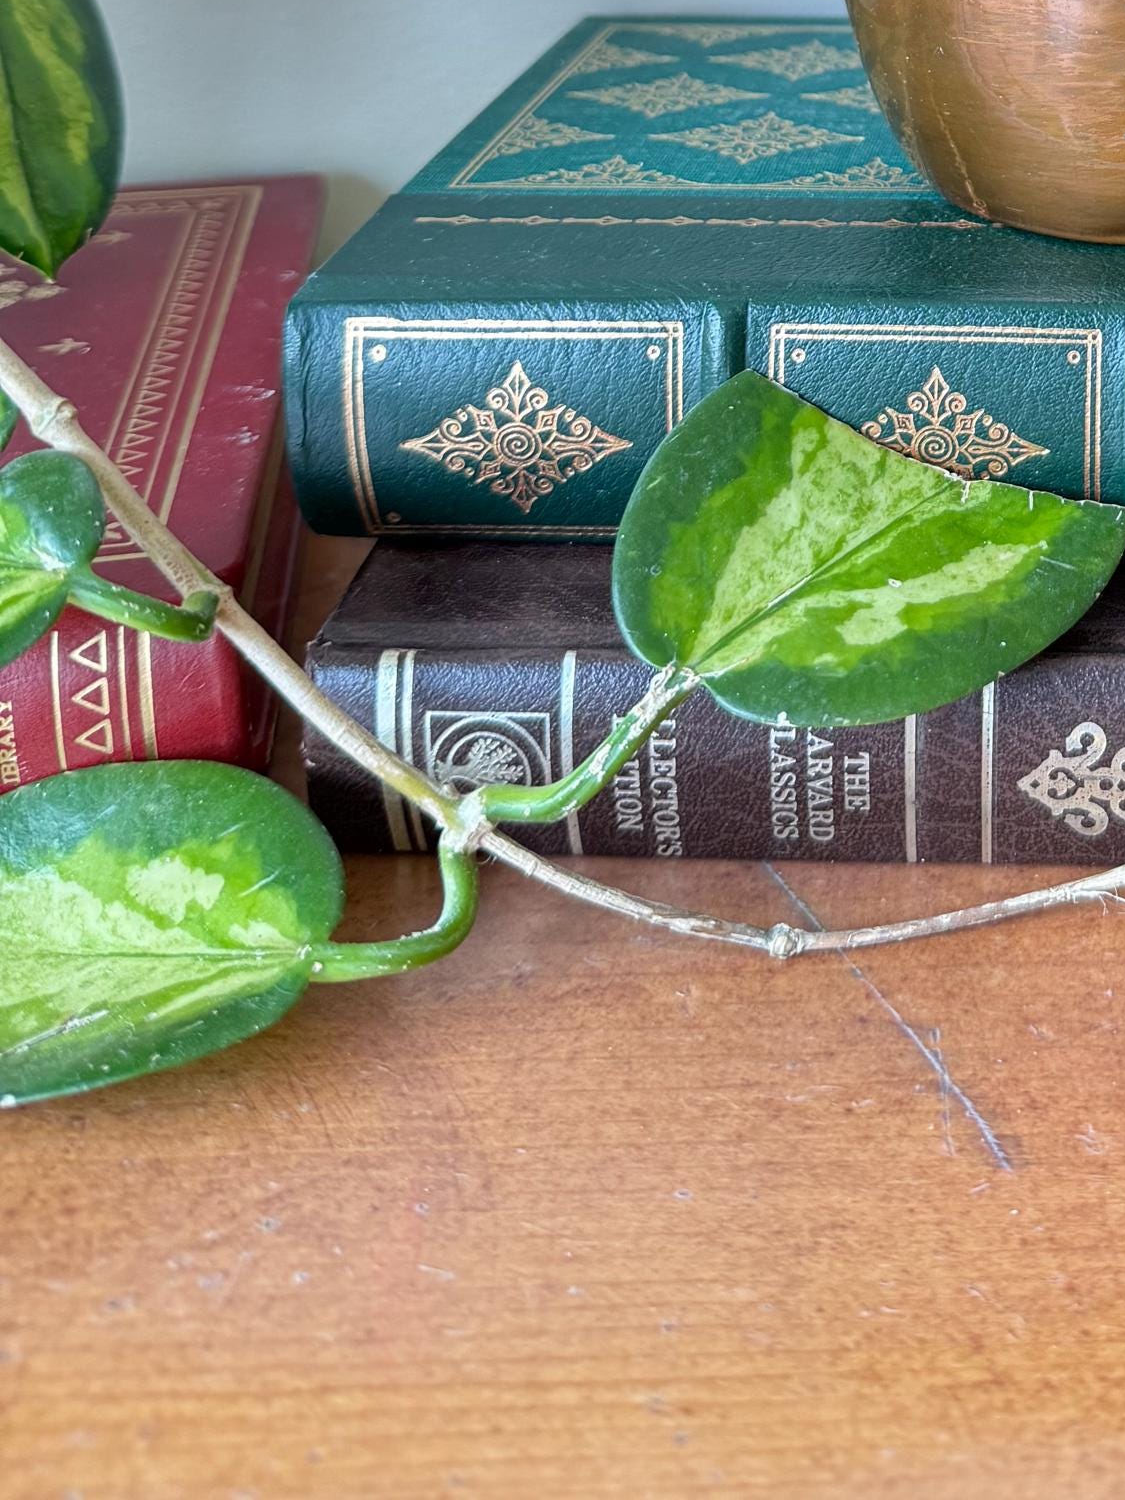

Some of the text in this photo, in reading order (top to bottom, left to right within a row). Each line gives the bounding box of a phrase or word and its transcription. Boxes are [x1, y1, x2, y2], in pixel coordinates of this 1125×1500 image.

[770, 726, 799, 839] LASSICS
[807, 726, 835, 841] ARVARD
[844, 751, 871, 811] THE
